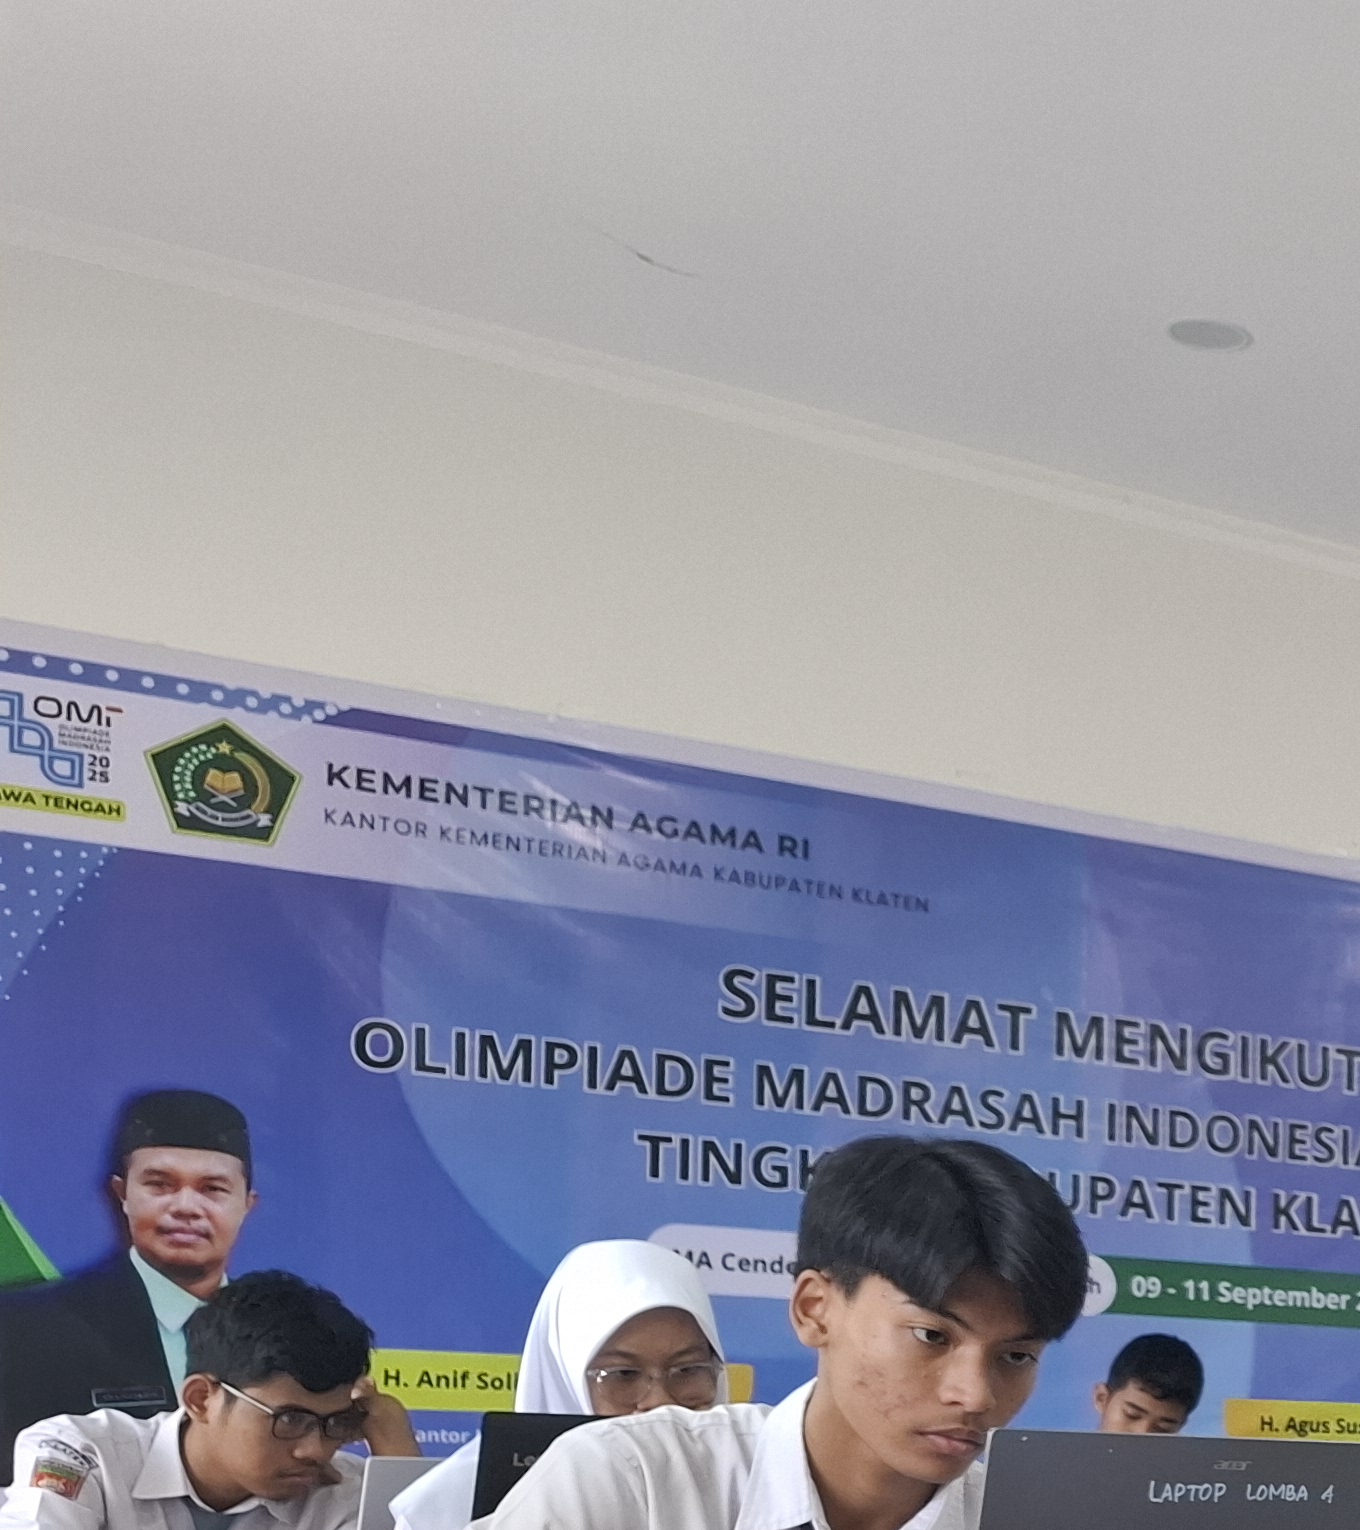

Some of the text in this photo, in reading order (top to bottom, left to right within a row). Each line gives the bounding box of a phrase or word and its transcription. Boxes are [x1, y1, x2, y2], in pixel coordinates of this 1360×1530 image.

[88, 753, 110, 769] 20
[87, 768, 110, 783] 25
[0, 789, 121, 816] WA TENGAH
[326, 761, 811, 861] KEMENTERIAN AGAMA RI
[323, 807, 930, 914] KANTOR KEMENTERIAN AGAMA KABUPATEN KLATEN
[720, 967, 1034, 1052] SELAMAT
[353, 1020, 734, 1104] OLIMPIADE
[755, 1063, 1086, 1140] MADRASAH
[1049, 1172, 1252, 1228] UPATEN
[1131, 1275, 1161, 1298] 09
[1183, 1279, 1210, 1301] 11
[1218, 1281, 1351, 1311] September
[384, 1368, 408, 1388] H.
[417, 1371, 469, 1390] Anif
[415, 1429, 468, 1445] antor
[1260, 1415, 1279, 1433] H.
[1285, 1418, 1331, 1438] Agus
[1214, 1459, 1251, 1471] acer
[1149, 1480, 1227, 1503] LAPTOP
[1247, 1483, 1309, 1502] LOMBA
